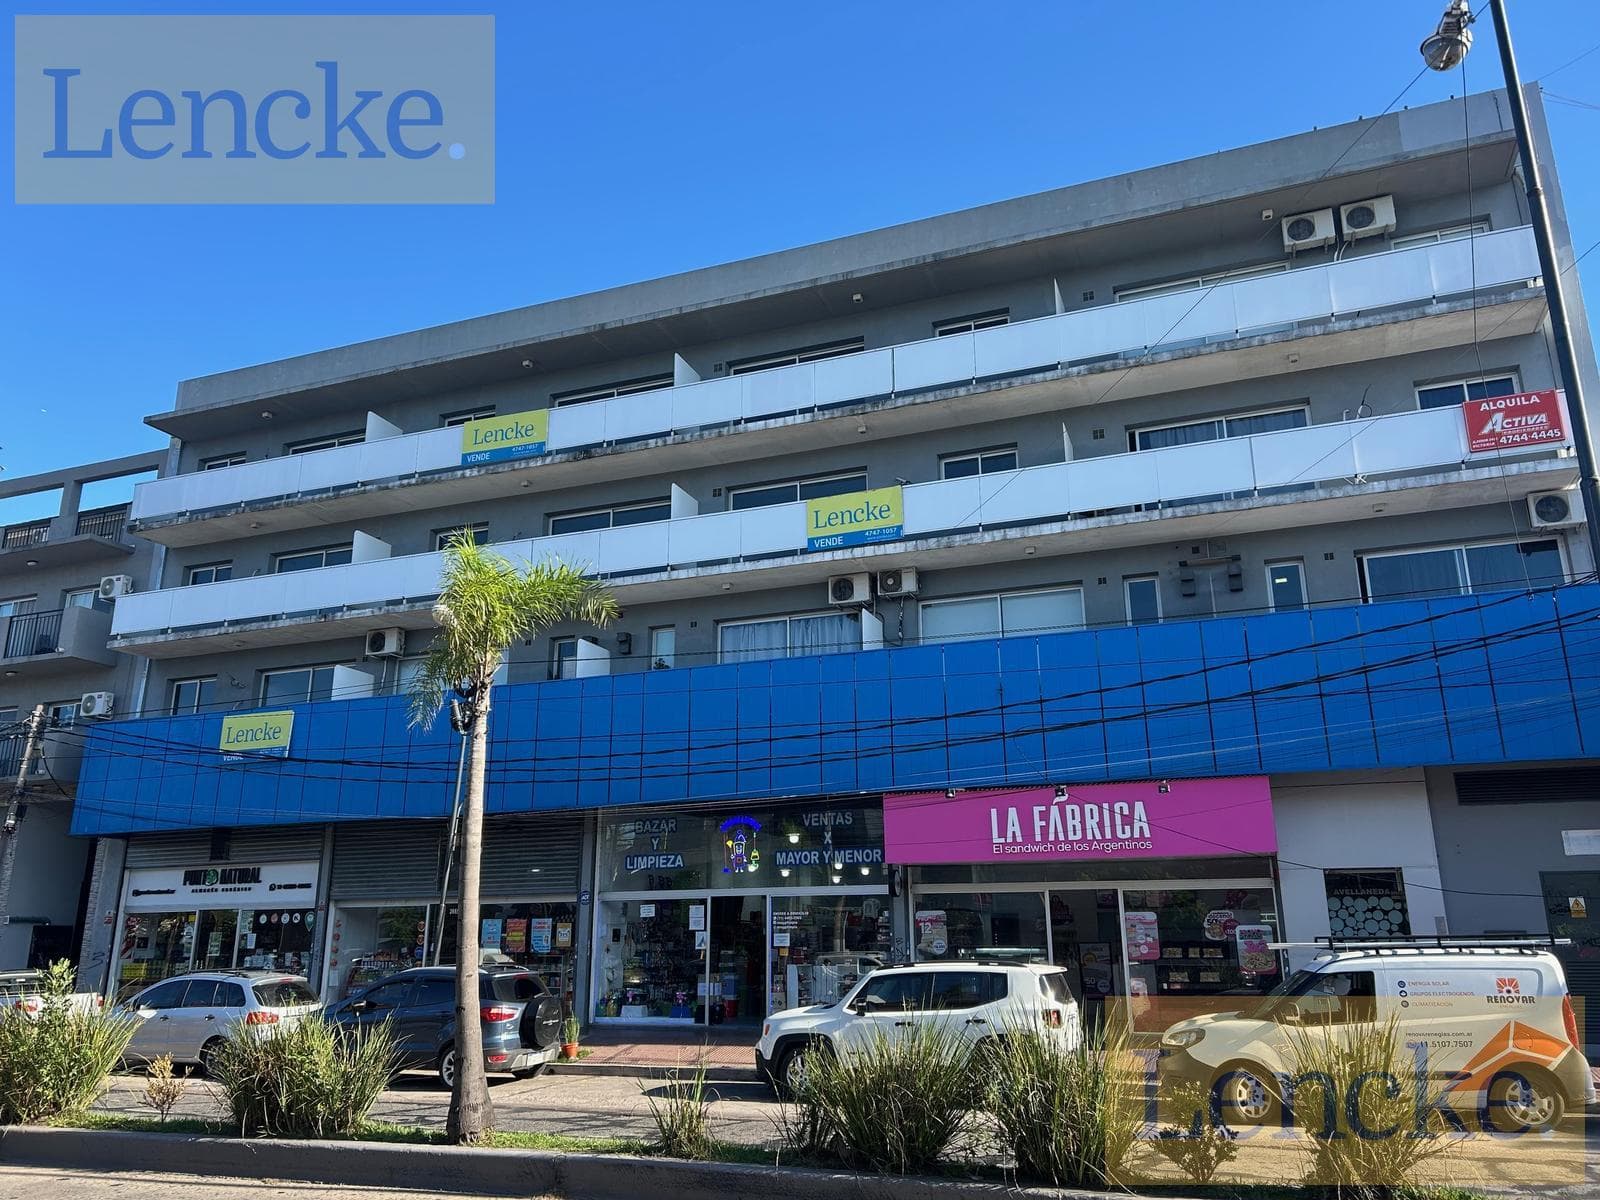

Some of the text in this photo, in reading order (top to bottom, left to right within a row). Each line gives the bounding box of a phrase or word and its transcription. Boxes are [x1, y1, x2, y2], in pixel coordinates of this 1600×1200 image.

[1480, 395, 1540, 411] ALQUILA
[473, 422, 534, 445] Lencke
[467, 452, 490, 462] VENDE
[814, 501, 890, 529] Lencke
[814, 527, 897, 548] VENDE 4747-1057
[225, 722, 282, 745] Lencke
[803, 812, 853, 826] VENTAS
[991, 793, 1151, 843] LA FÁBRICA
[635, 819, 677, 833] BAZAR
[651, 838, 660, 850] Y
[824, 832, 832, 844] X
[993, 840, 1153, 854] El sandwich de los Argentinos
[627, 855, 684, 869] LIMPIEZA
[776, 849, 882, 865] MAYOR Y MENOR
[219, 867, 262, 884] NATURAL
[1333, 888, 1391, 896] AVELLANEDA
[1486, 995, 1536, 1004] RENOVAR
